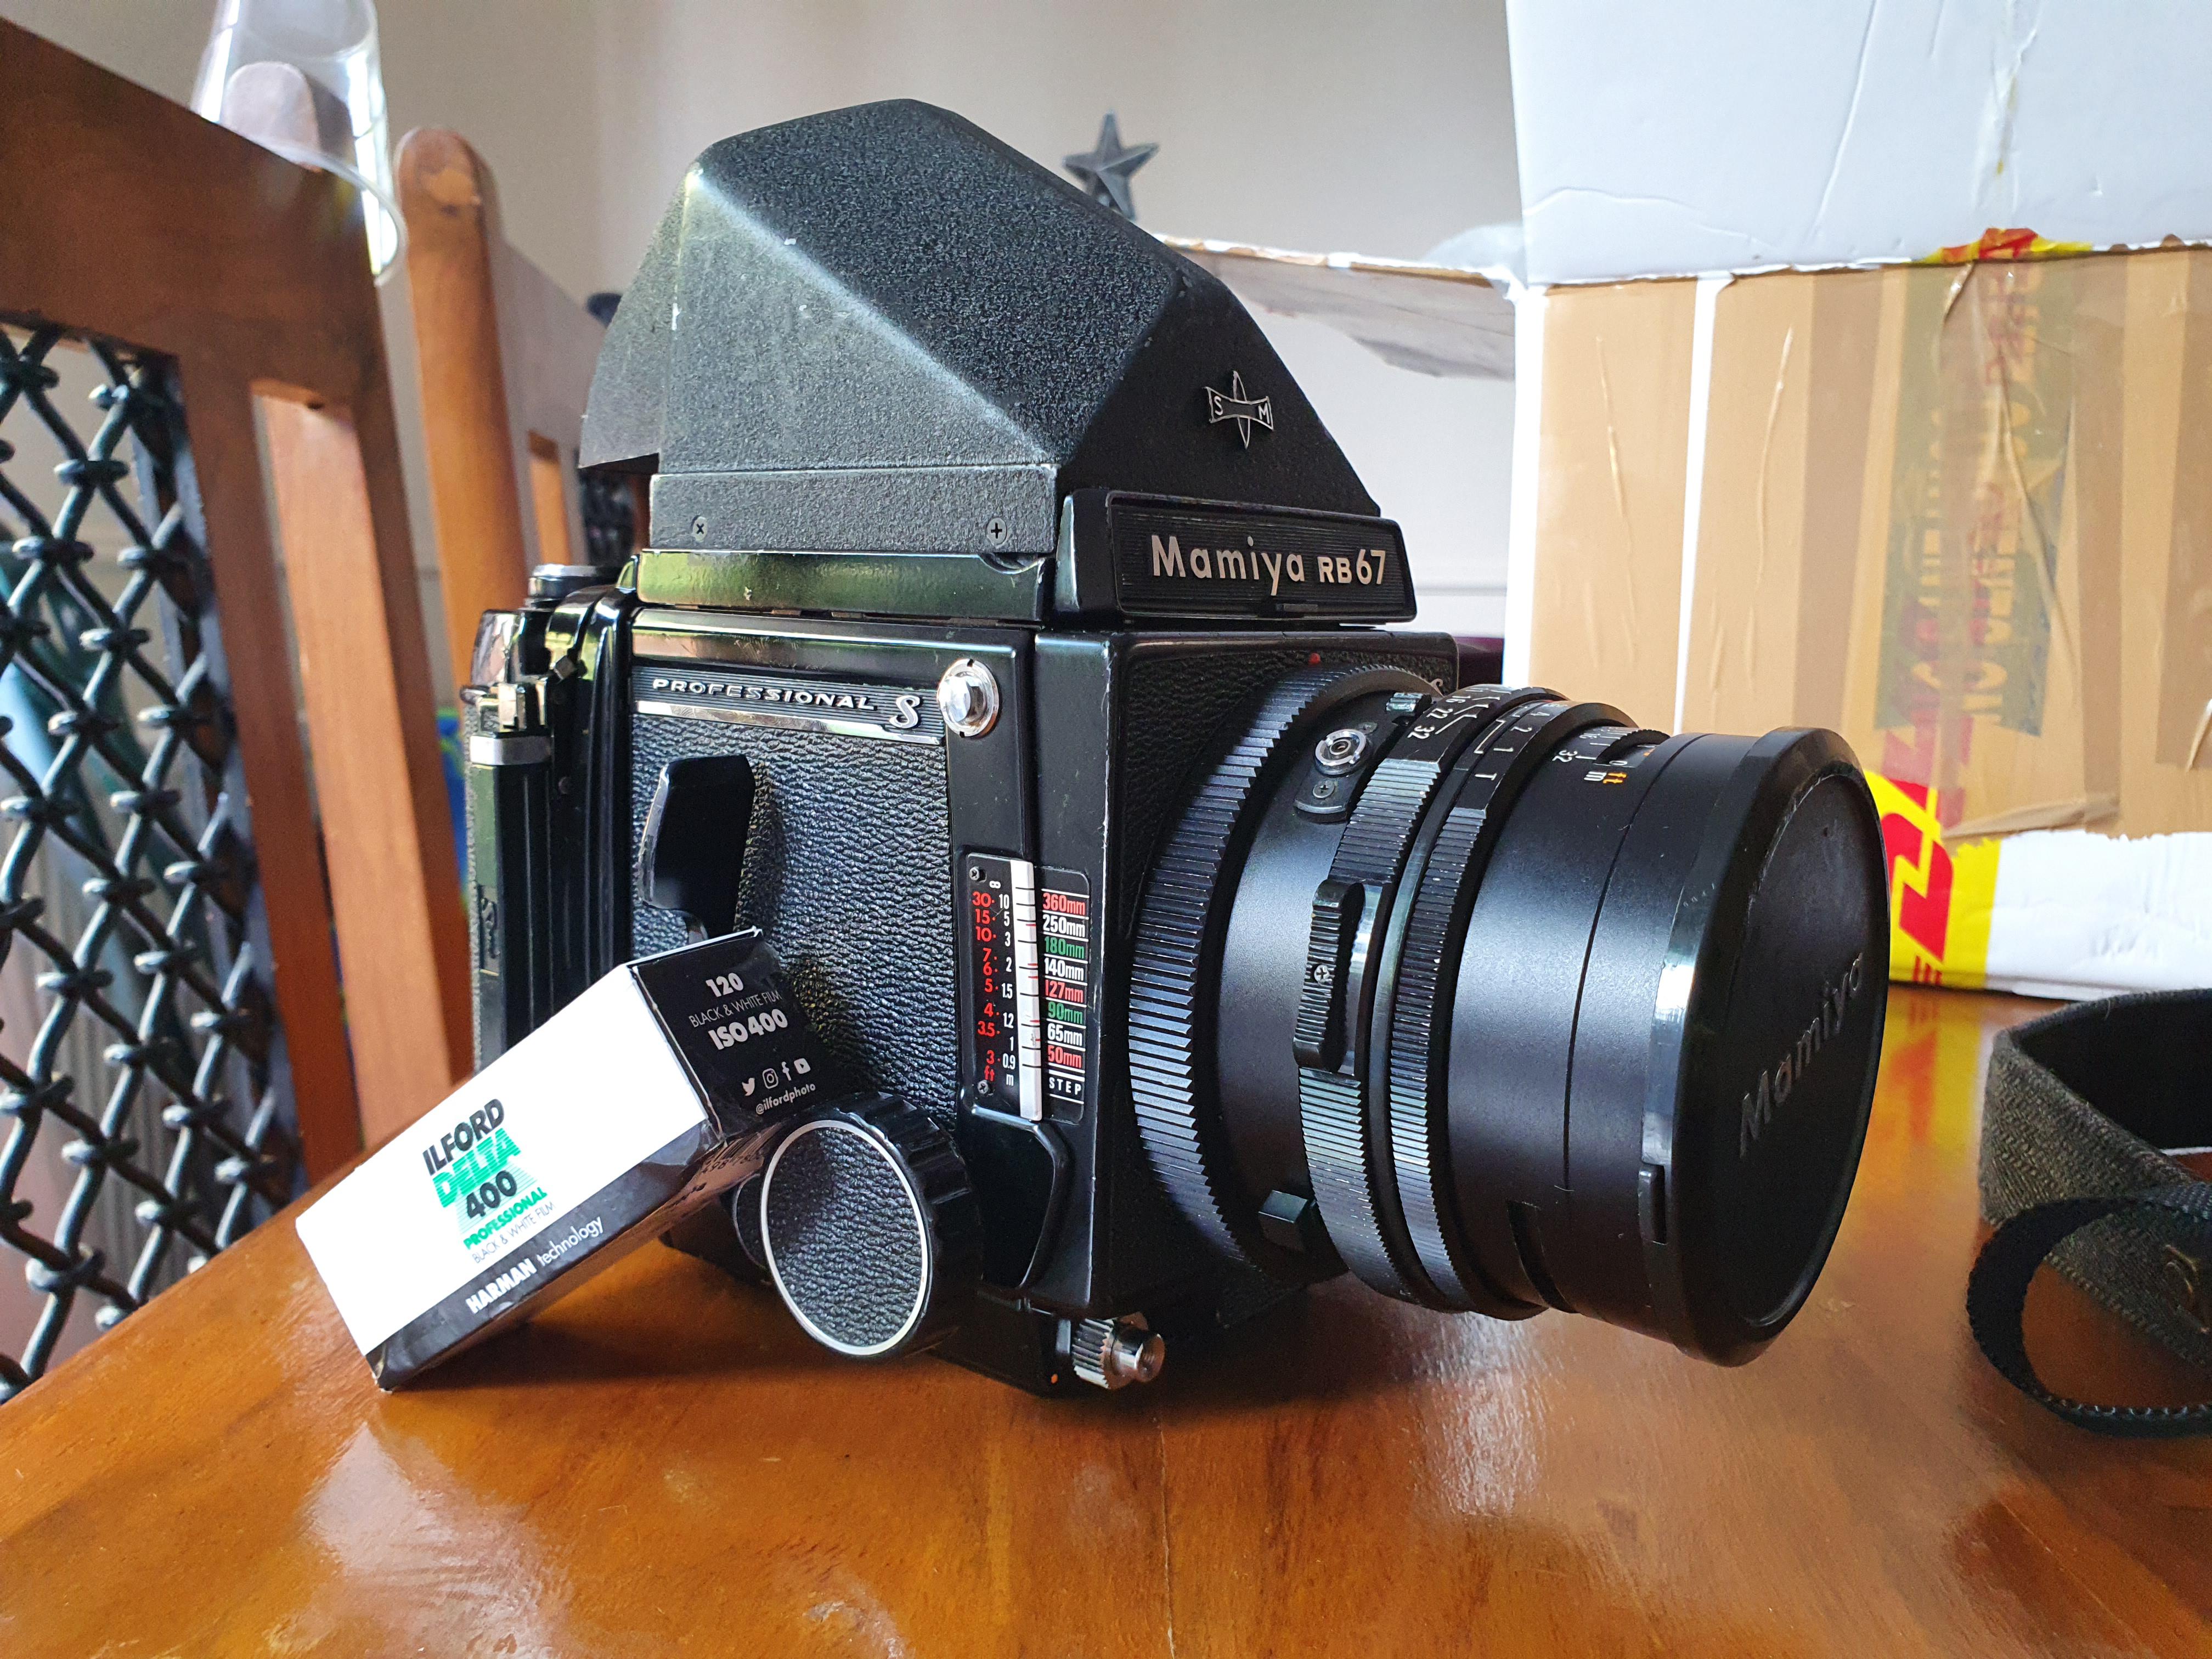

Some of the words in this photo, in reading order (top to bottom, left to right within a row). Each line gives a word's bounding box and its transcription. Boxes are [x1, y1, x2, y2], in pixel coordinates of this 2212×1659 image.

[1151, 534, 1305, 597] Mamiya
[1318, 549, 1386, 585] RB67
[652, 678, 877, 711] PROFESSIONAL
[888, 695, 921, 729] S
[1407, 725, 1435, 740] 32
[1551, 750, 1578, 763] 32
[973, 891, 991, 907] 30
[999, 894, 1009, 909] 10
[1043, 892, 1086, 916] 360mm
[975, 909, 990, 924] 15
[1003, 912, 1010, 926] 5
[1043, 915, 1085, 938] 250mm
[976, 926, 992, 941] 10
[1005, 932, 1011, 946] 3
[1045, 936, 1085, 958] 180mm
[983, 948, 992, 961] 7
[1006, 957, 1012, 972] 2
[983, 962, 992, 975] 6
[1045, 957, 1084, 981] 140mm
[706, 972, 744, 997] 120
[984, 978, 992, 992] 5
[1046, 980, 1084, 1003] 127mm
[689, 1007, 724, 1028] BLACK
[723, 1005, 733, 1015] &
[731, 995, 764, 1012] WHITE
[762, 990, 782, 1003] FILM
[984, 1003, 994, 1016] 4
[1048, 1002, 1083, 1024] 90mm
[708, 1022, 748, 1050] ISO
[748, 1008, 788, 1036] 400
[1047, 1024, 1082, 1046] 65mm
[1009, 1036, 1013, 1051] 1
[1740, 952, 1863, 1158] Mamiya
[986, 1050, 994, 1064] 3
[1003, 1053, 1015, 1070] 0.9
[1047, 1045, 1082, 1068] 50mm
[984, 1065, 995, 1081] ft
[1006, 1073, 1014, 1086] m
[1049, 1077, 1082, 1094] STEP
[756, 1083, 816, 1115] @ilfordphoto
[422, 1098, 505, 1176] ILFORD
[432, 1127, 521, 1207] DELTA
[466, 1170, 517, 1219] 400
[463, 1187, 548, 1249] PROFESSIONAL
[472, 1239, 500, 1264] BLACK
[501, 1233, 509, 1244] &
[507, 1216, 536, 1238] WHITE
[534, 1201, 555, 1221] FILM
[465, 1258, 537, 1314] HARMAN
[537, 1216, 603, 1267] technology
